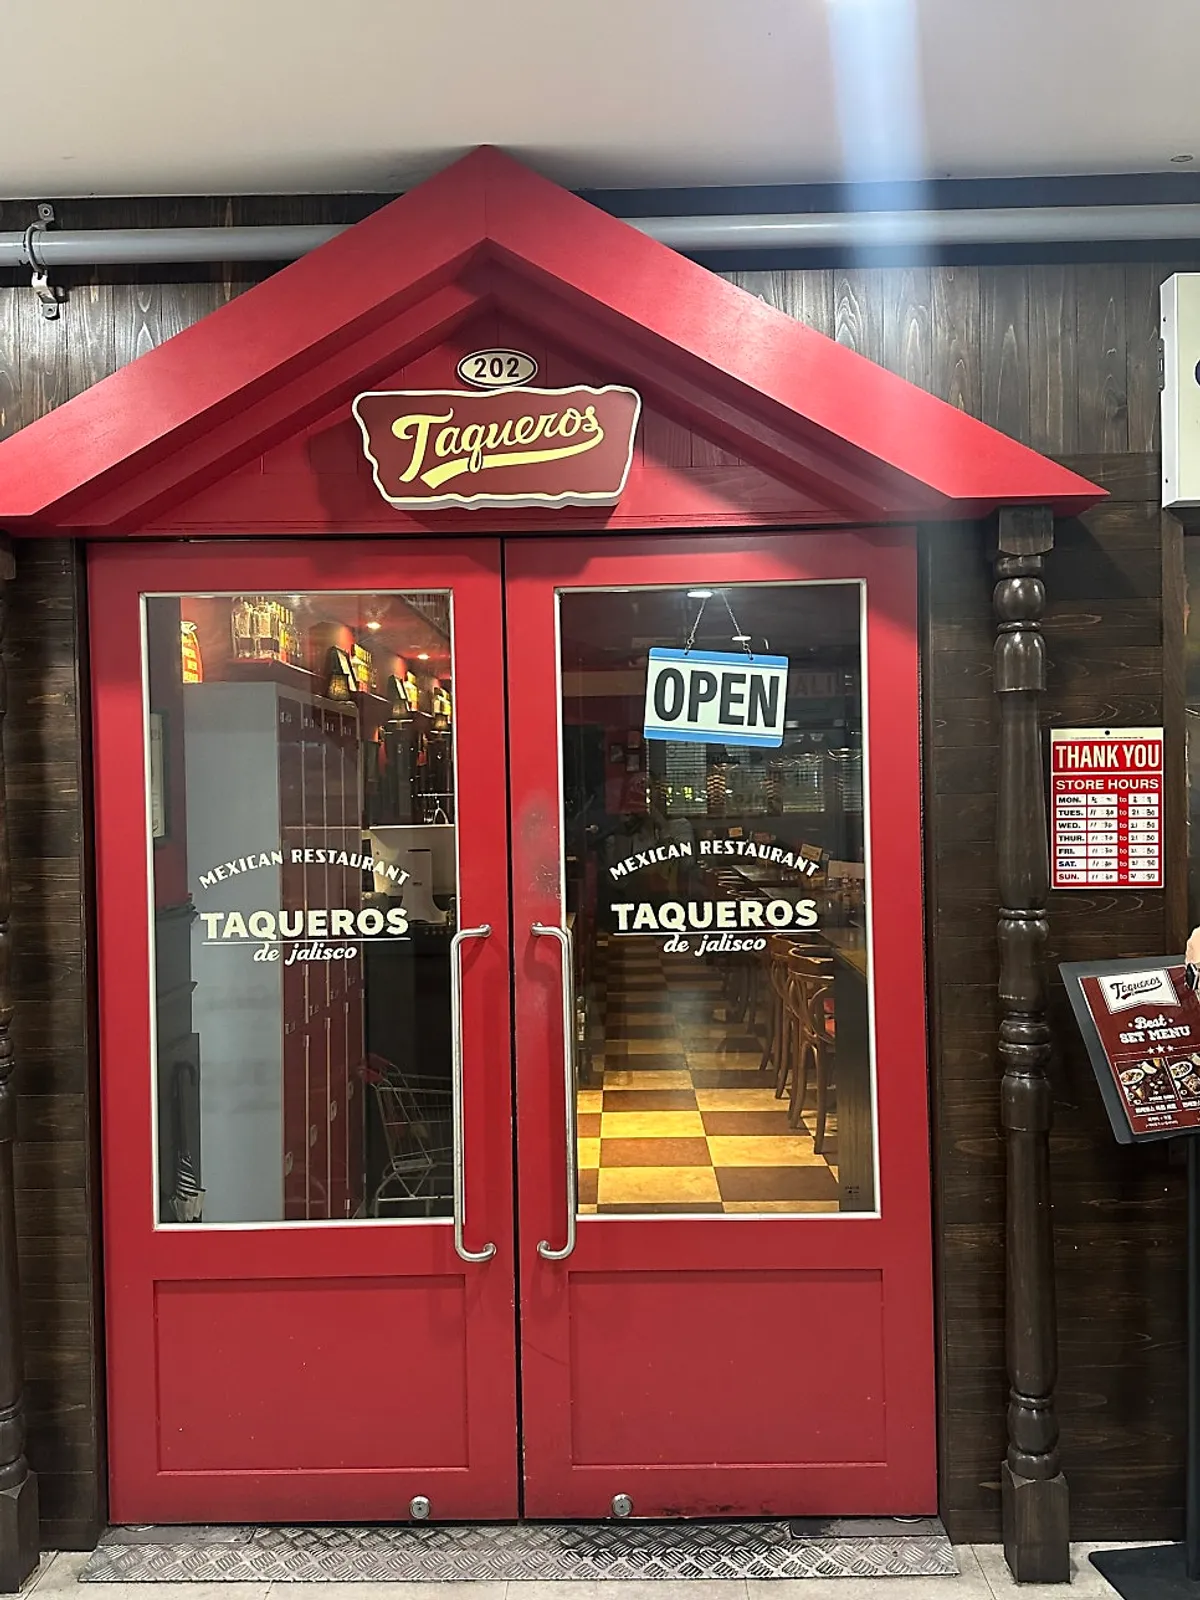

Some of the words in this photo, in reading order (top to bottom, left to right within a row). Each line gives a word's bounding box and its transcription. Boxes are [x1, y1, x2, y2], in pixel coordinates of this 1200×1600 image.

[474, 357, 520, 378] 202
[391, 404, 605, 490] Taqueros
[652, 667, 781, 729] OPEN
[1055, 744, 1119, 769] THANK
[1122, 744, 1159, 768] YOU
[1056, 779, 1104, 790] STORE
[1108, 778, 1159, 790] HOURS
[198, 850, 283, 889] MEXICAN
[291, 848, 410, 885] RESTAURANT
[609, 841, 692, 881] MEXICAN
[700, 839, 819, 878] RESTAURANT
[200, 908, 409, 940] TAQUEROS
[611, 899, 818, 931] TAQUEROS
[253, 943, 279, 962] de
[285, 941, 357, 965] jalisco
[663, 933, 689, 954] de
[694, 932, 766, 957] jalisco
[1134, 1014, 1168, 1029] Best
[1119, 1031, 1145, 1044] SET
[1148, 1026, 1191, 1042] MENU
